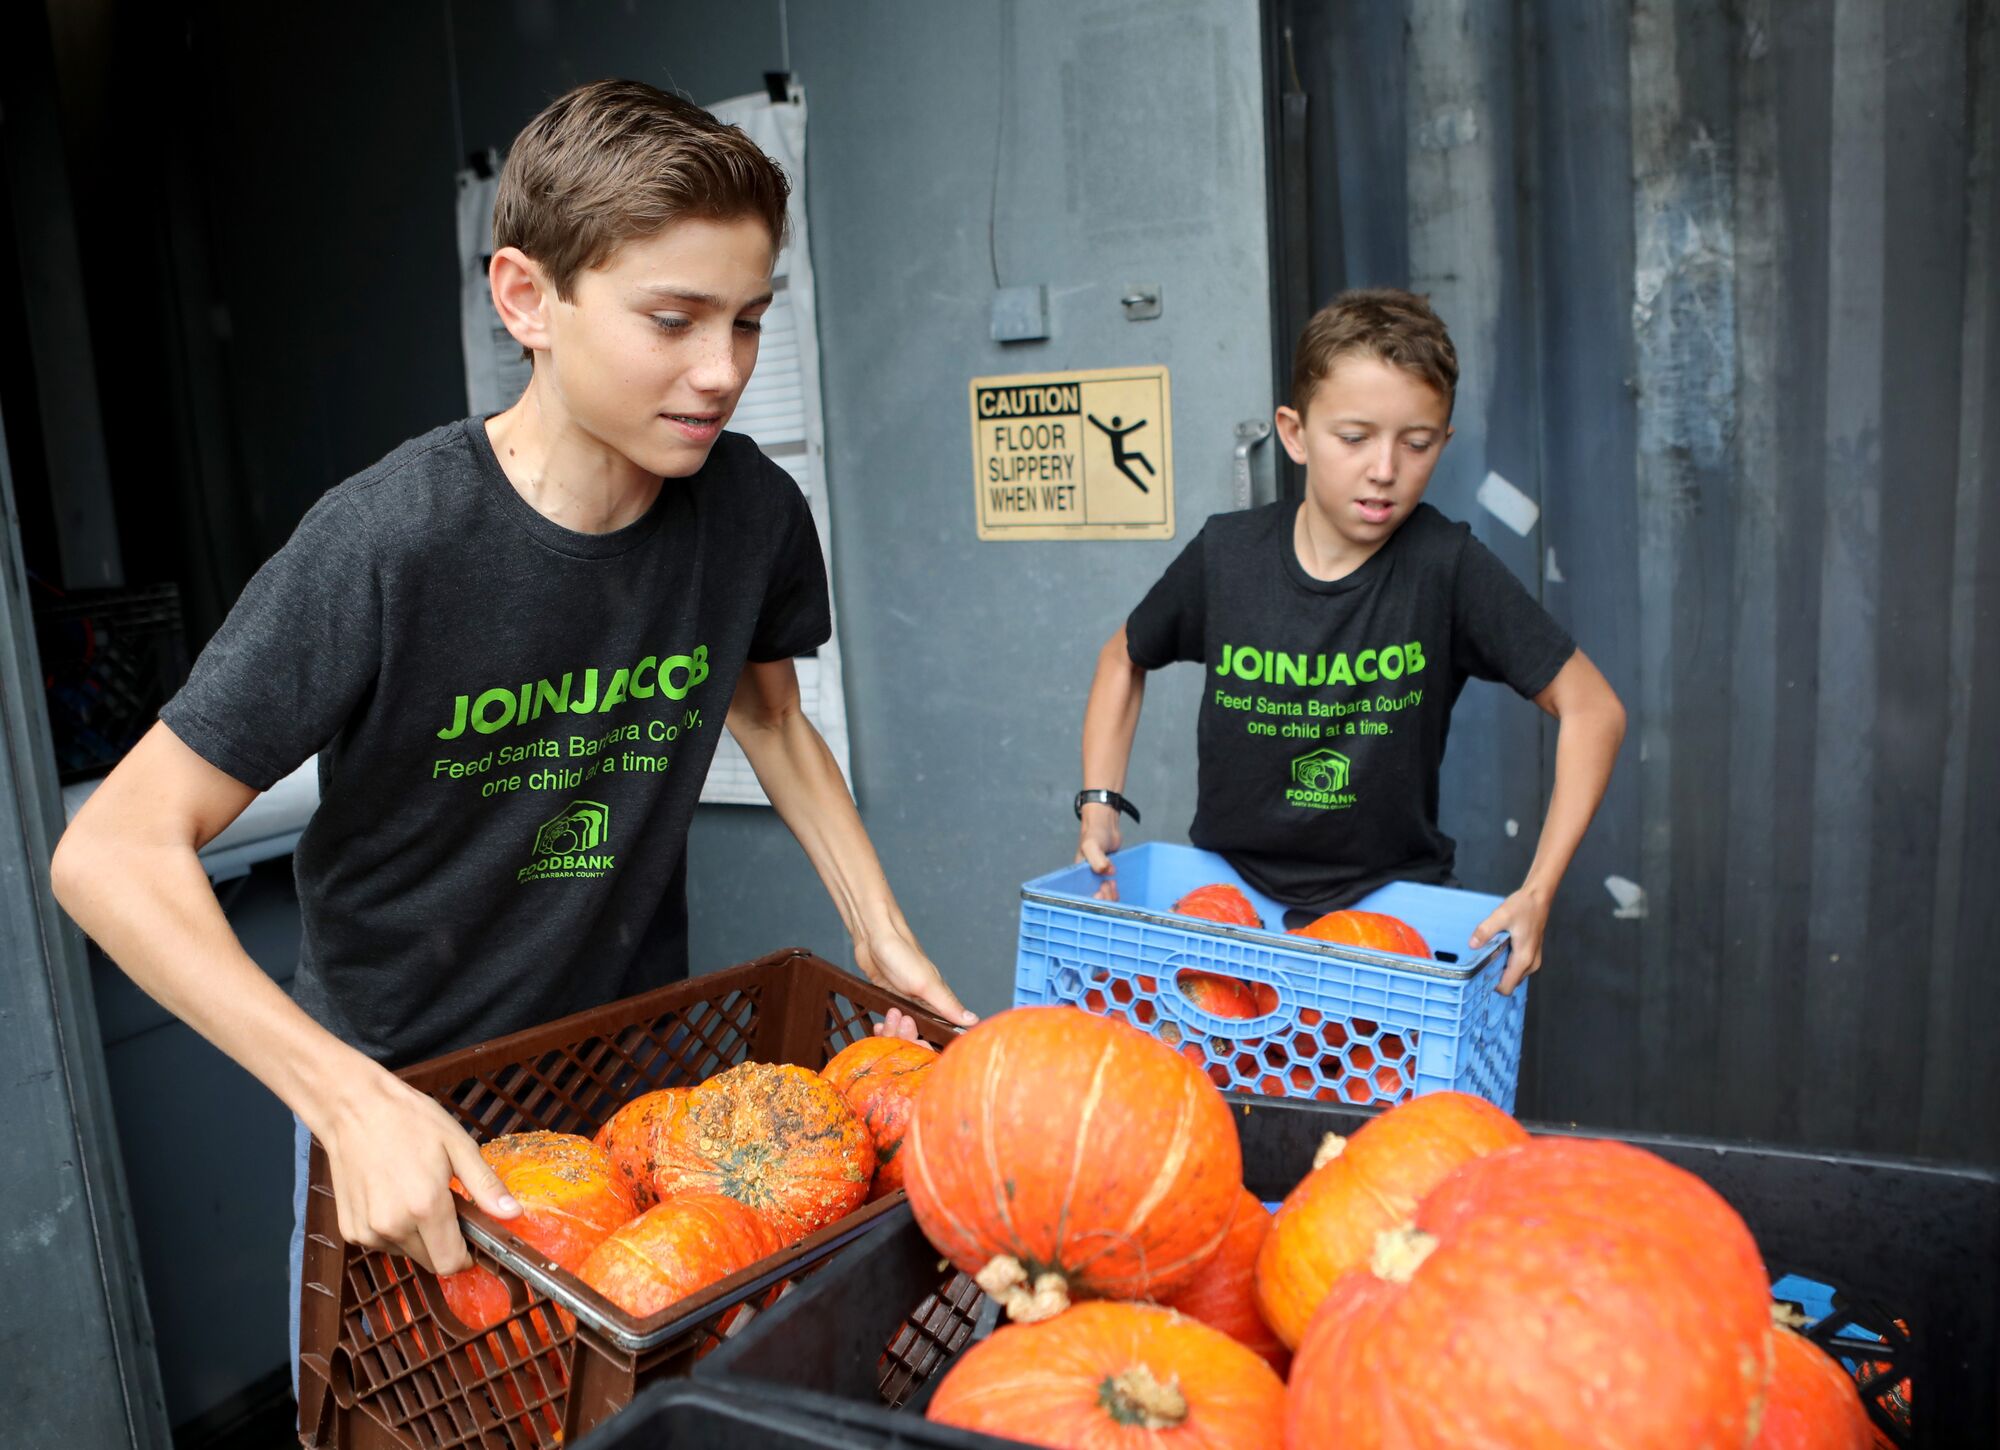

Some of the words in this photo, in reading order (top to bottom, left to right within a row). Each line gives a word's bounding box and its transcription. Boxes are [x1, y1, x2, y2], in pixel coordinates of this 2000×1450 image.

[979, 385, 1078, 417] CAUTION
[995, 424, 1065, 451] FLOOR
[988, 455, 1074, 482] SLIPPERY
[990, 487, 1036, 512] WHEN
[1042, 486, 1075, 511] WET
[1215, 641, 1426, 686] JOINJACOB
[437, 645, 710, 739] JOINJACOB
[1216, 690, 1252, 711] Feed
[1256, 696, 1303, 716] Santa
[1308, 699, 1371, 717] Barbara
[1248, 722, 1277, 736] one
[1282, 723, 1320, 738] child
[1326, 726, 1340, 737] at
[1345, 723, 1355, 735] a
[1360, 719, 1393, 735] time.
[432, 752, 493, 779] Feed
[498, 738, 560, 765] Santa
[482, 775, 521, 798] one
[528, 769, 581, 790] child
[603, 757, 615, 773] a
[1286, 789, 1357, 803] FOODBANK
[517, 855, 615, 880] FOODBANK
[540, 871, 575, 879] BARBARA
